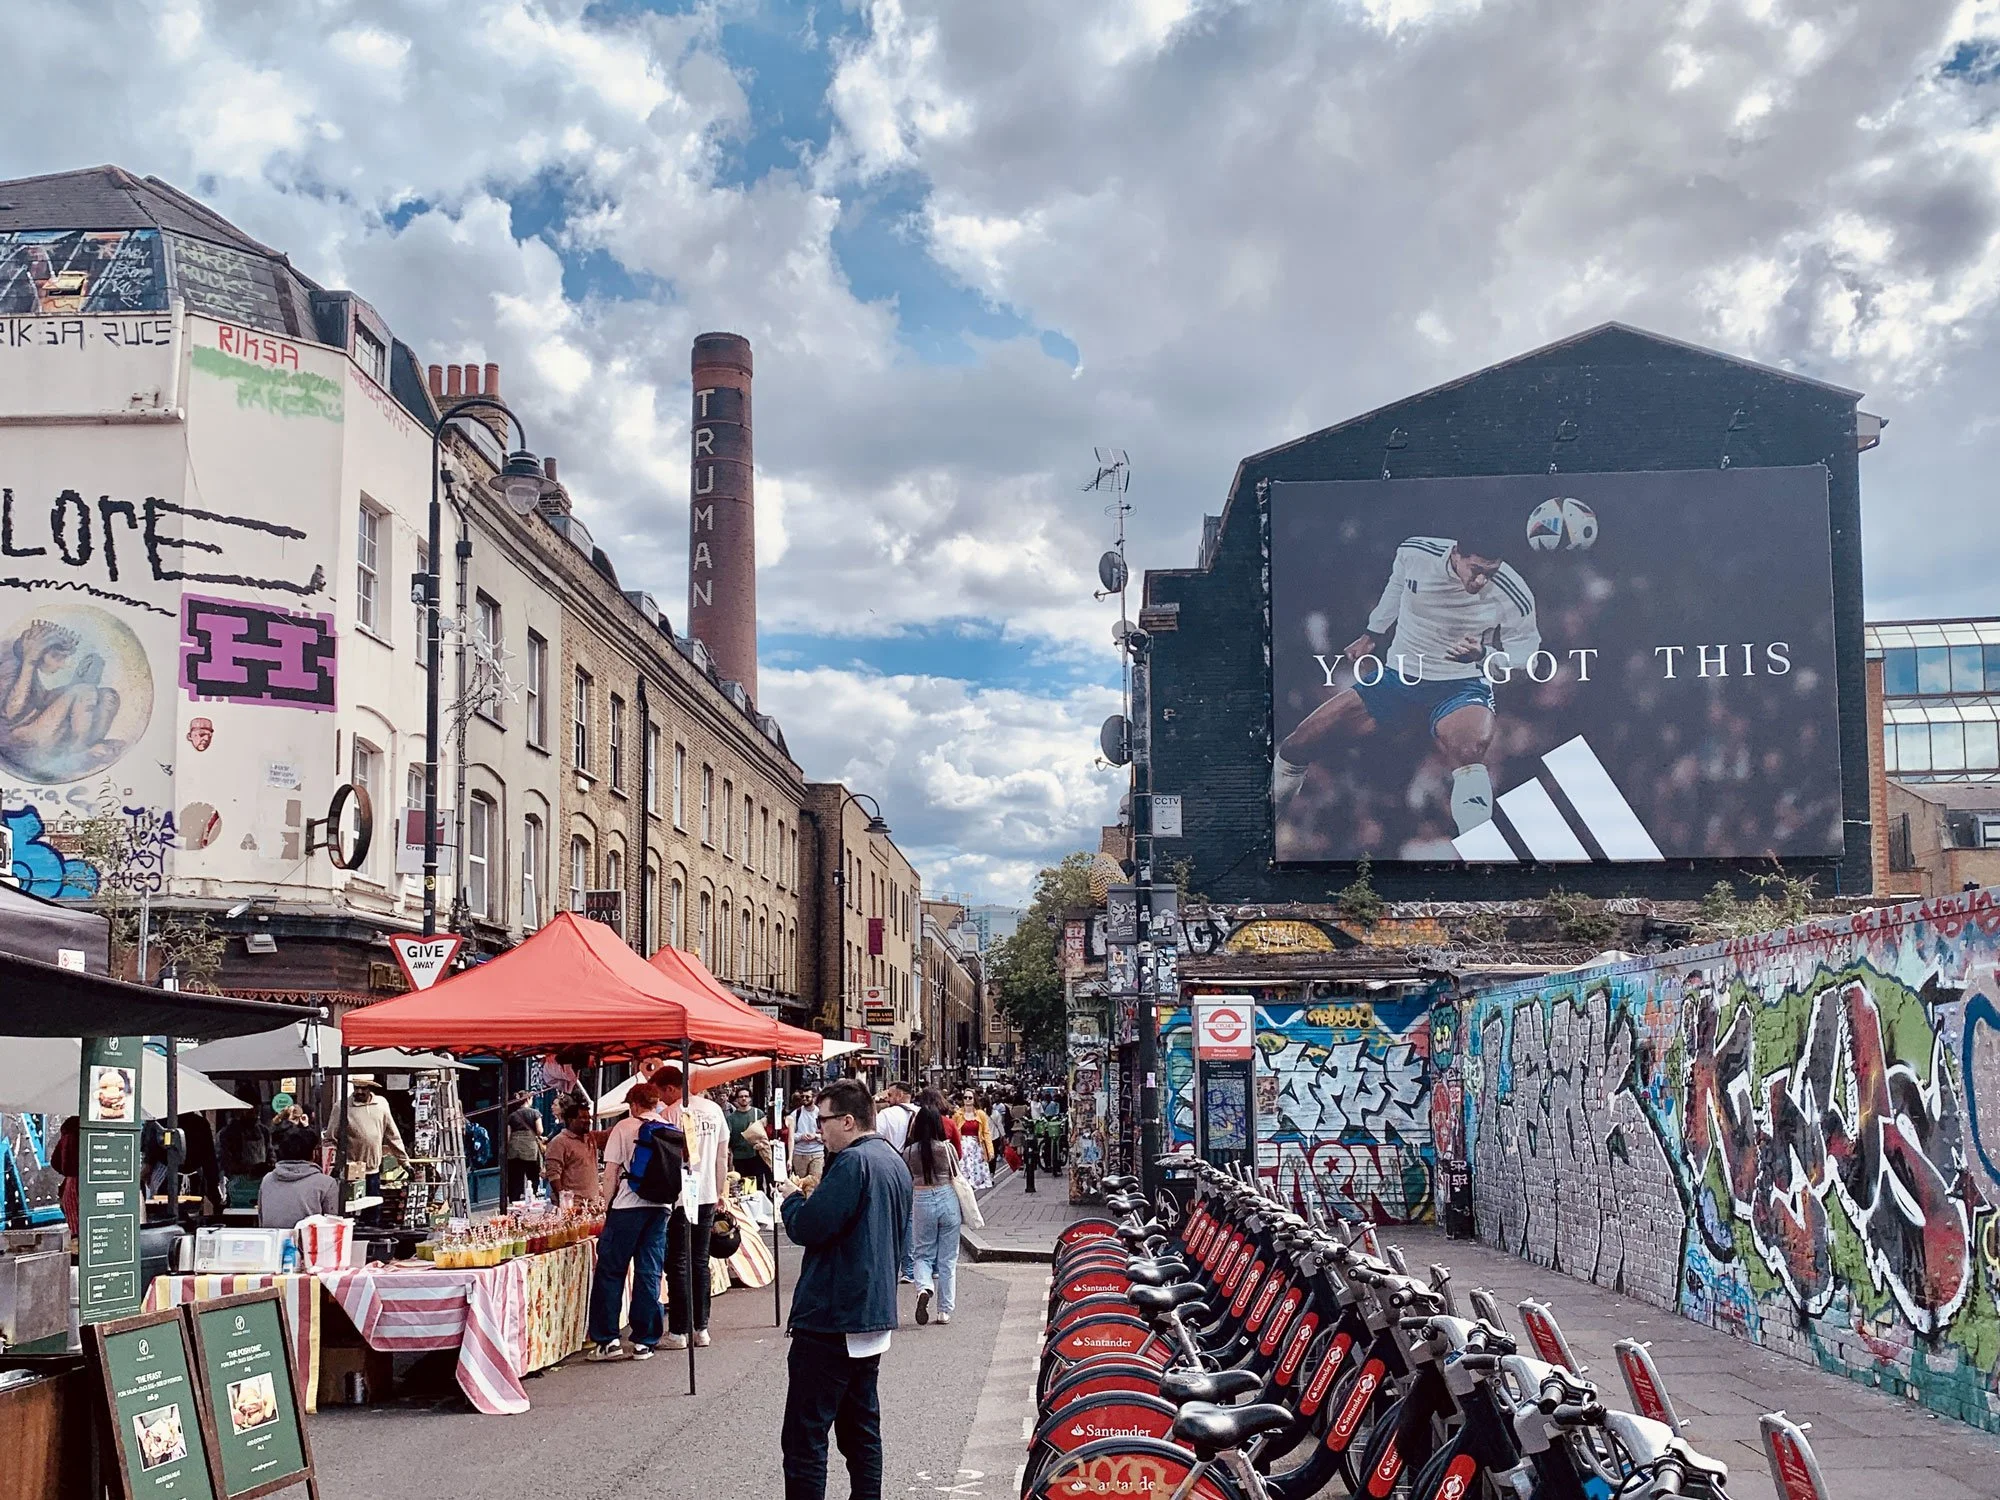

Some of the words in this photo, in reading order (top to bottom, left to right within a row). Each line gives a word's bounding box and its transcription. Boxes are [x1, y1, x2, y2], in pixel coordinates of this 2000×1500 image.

[218, 325, 299, 370] RIKSA
[693, 388, 715, 608] TRUMAN
[1313, 653, 1425, 687] YOU
[1483, 649, 1599, 684] GOT
[1655, 641, 1793, 680] THIS
[588, 910, 621, 921] CAB
[407, 946, 444, 958] GIVE
[413, 961, 435, 969] AWAY
[1084, 1337, 1132, 1347] Santander
[1314, 1365, 1332, 1393] Santander
[1342, 1394, 1363, 1426] Santander
[1086, 1424, 1151, 1438] Santander
